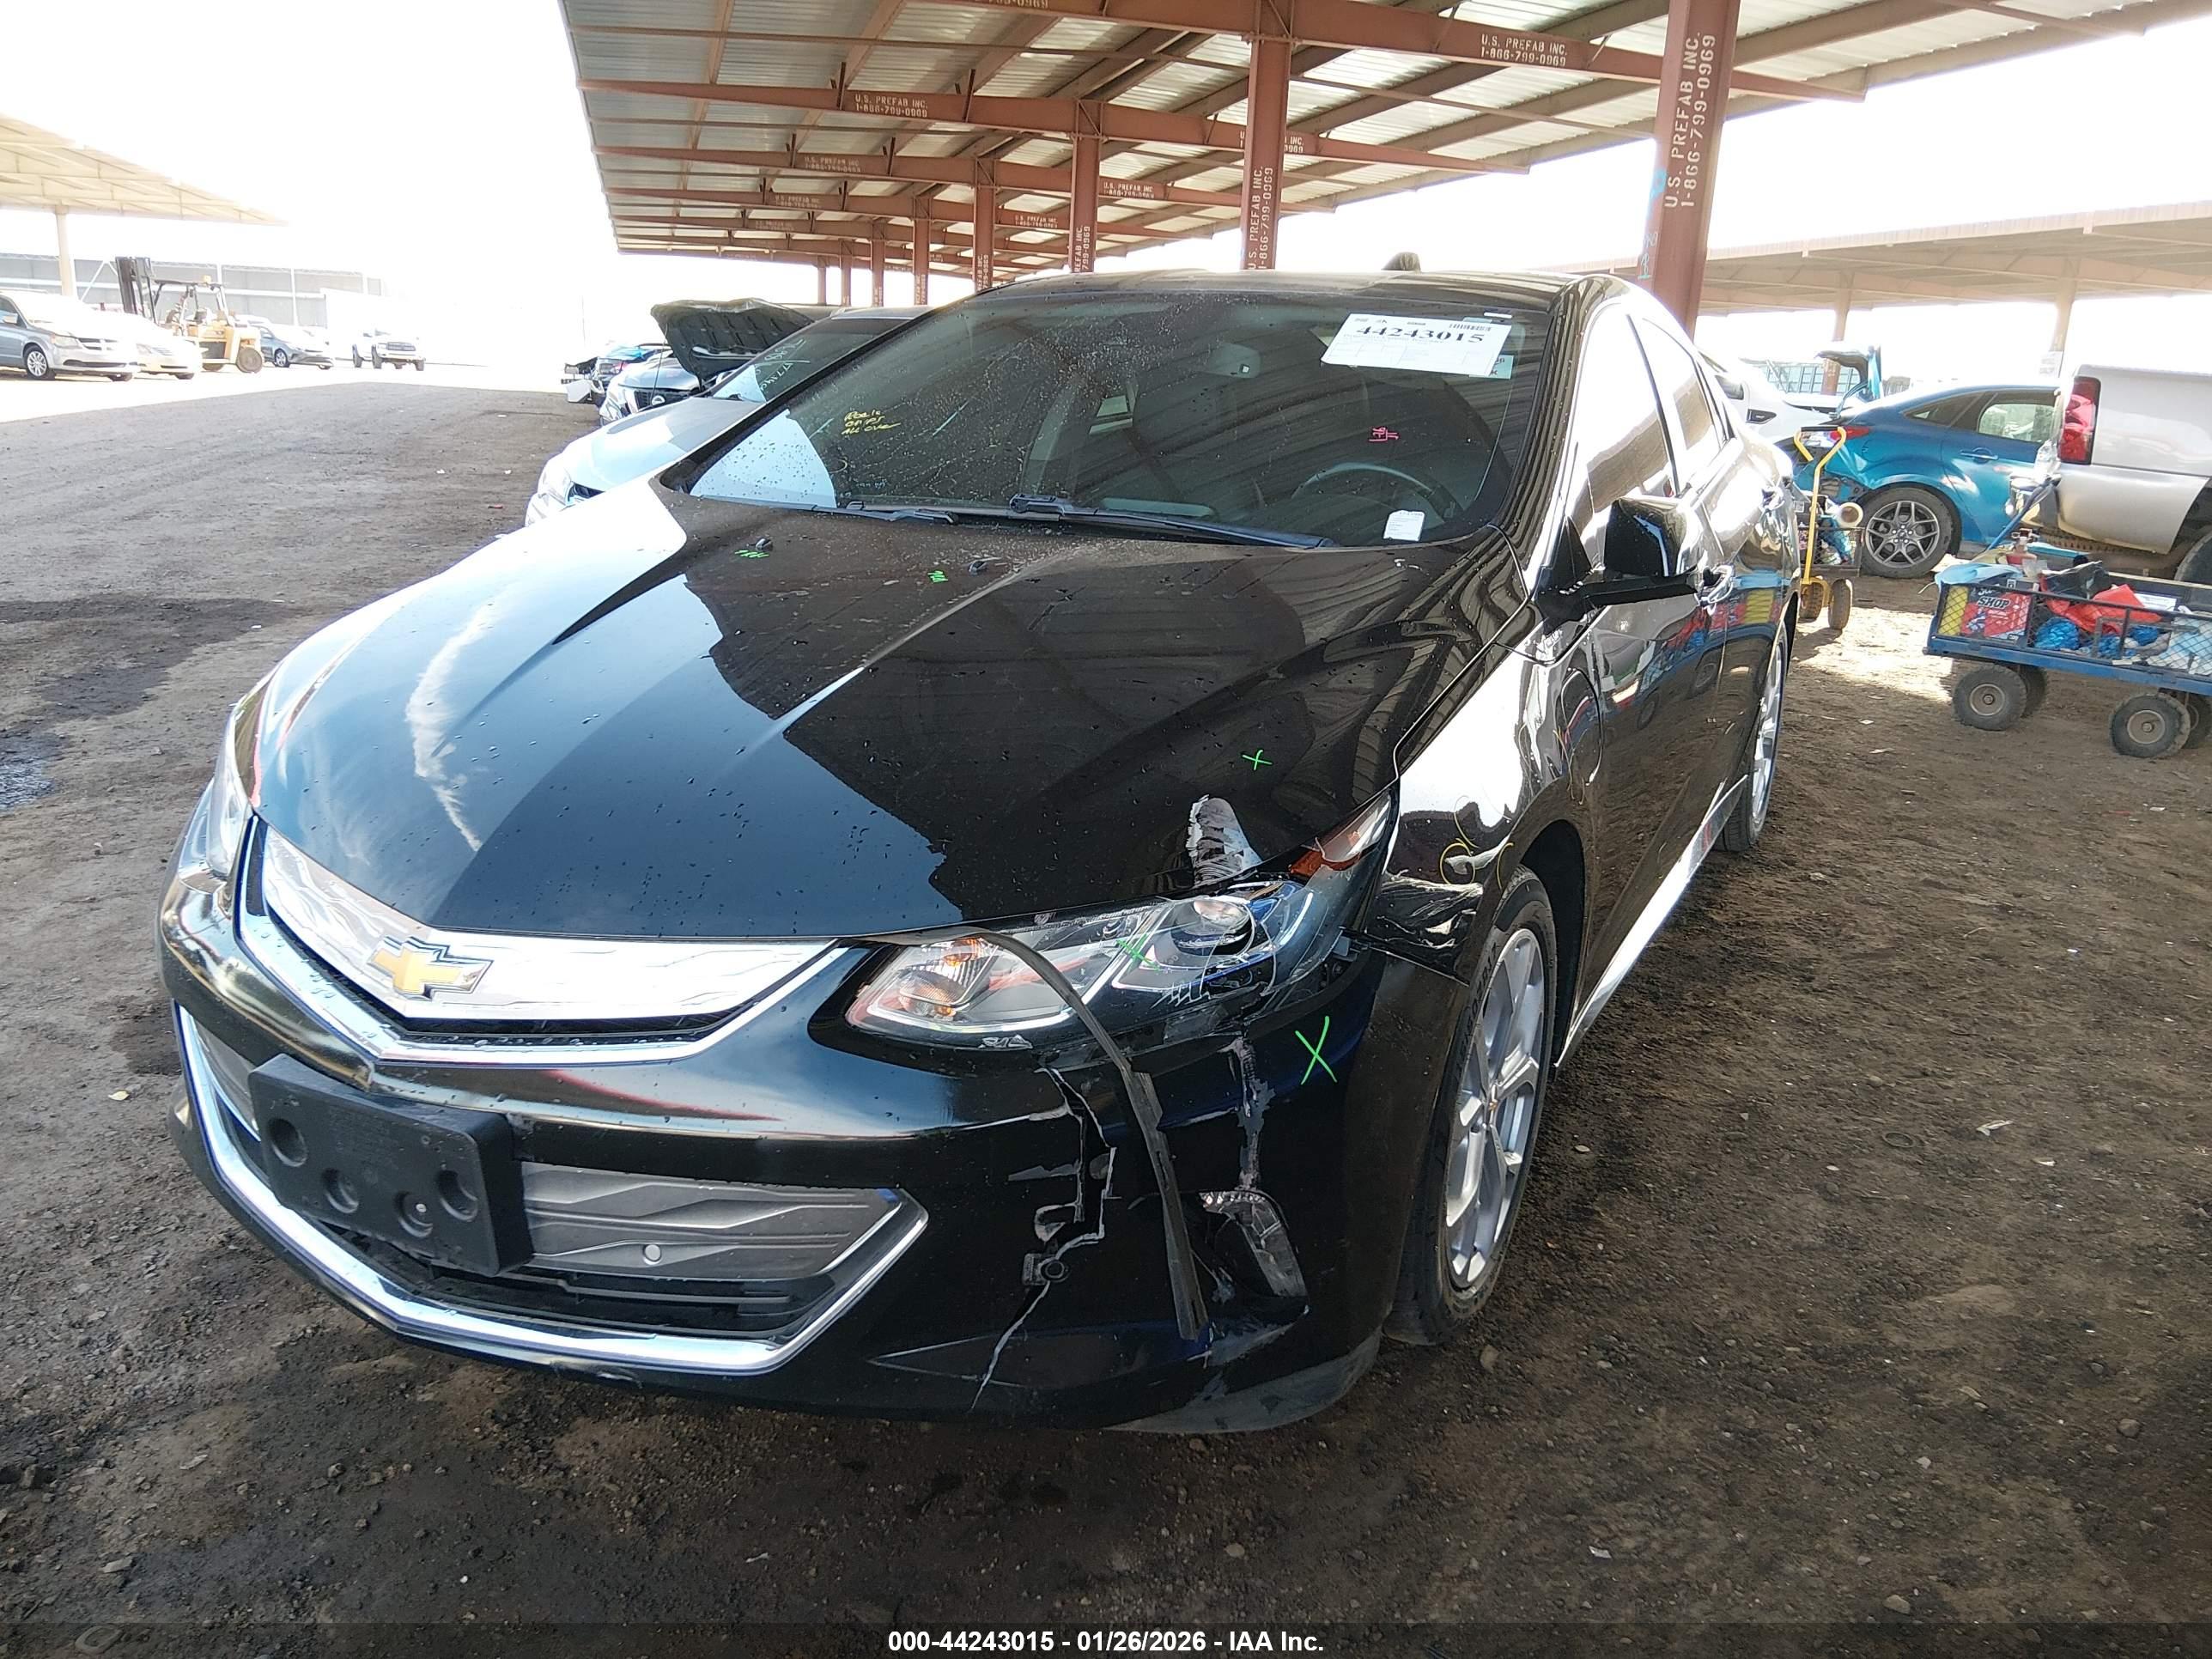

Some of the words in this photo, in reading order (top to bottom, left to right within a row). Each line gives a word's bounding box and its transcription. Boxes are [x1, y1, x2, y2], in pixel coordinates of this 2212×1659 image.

[1480, 34, 1500, 47] U.S.
[1505, 38, 1545, 52] PREFAB
[1549, 43, 1568, 56] INC.
[1480, 46, 1567, 67] 1-866-799-0969
[1683, 32, 1702, 70] INC.
[1671, 81, 1693, 159] PREFAB
[1680, 35, 1716, 207] 1-866-799-0969
[1253, 166, 1263, 189] INC.
[1664, 171, 1681, 208] U.S.
[1249, 195, 1261, 241] PREFAB
[1258, 167, 1273, 269] 1-866-799-0969
[1082, 226, 1091, 270] 799-0969
[1248, 248, 1258, 270] U.S.
[1356, 326, 1486, 343] 44243015
